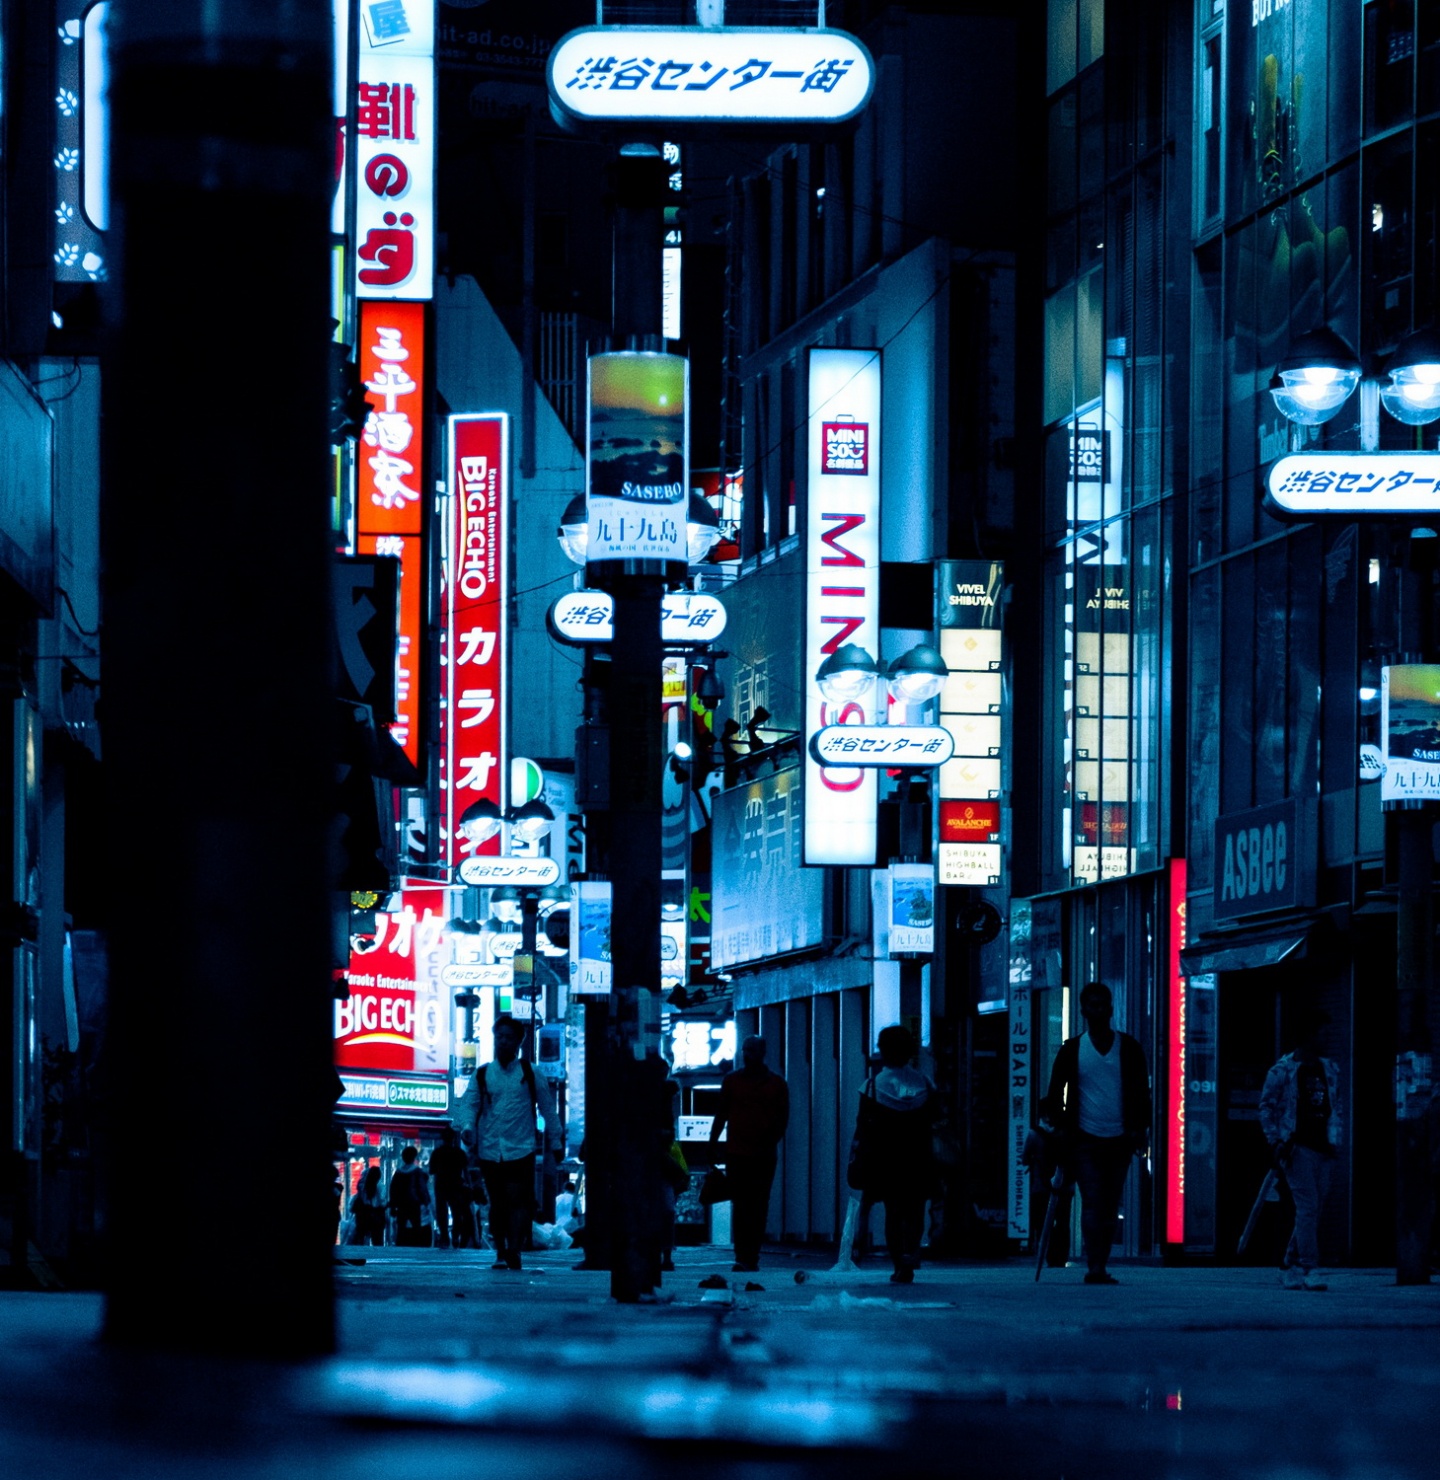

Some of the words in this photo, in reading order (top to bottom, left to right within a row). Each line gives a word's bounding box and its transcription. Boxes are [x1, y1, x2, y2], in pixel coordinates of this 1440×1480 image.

[566, 56, 855, 93] 渋谷センター街
[358, 82, 416, 286] 靴のダ
[826, 429, 865, 443] MINI
[461, 456, 487, 512] BIG
[488, 468, 497, 508] Karaoke
[621, 481, 682, 500] SASEBO
[1279, 470, 1440, 493] 渋谷センター
[595, 517, 678, 545] 九十九島
[460, 516, 487, 599] ECHO
[486, 511, 497, 583] Entertainment
[949, 595, 994, 606] SHIBUYA
[957, 584, 986, 595] VIVEL
[455, 626, 497, 853] カラオ
[823, 737, 945, 753] 渋谷センター街
[1394, 771, 1440, 788] 九十九
[946, 818, 992, 828] AVALANCHE
[946, 849, 987, 857] SHIBUYA
[946, 861, 994, 869] HIGHBALL
[464, 865, 554, 878] 渋谷センター街
[445, 970, 510, 980] 渋谷センター街
[335, 993, 378, 1039] BIG
[380, 997, 442, 1046] ECHO
[1012, 1043, 1028, 1088] BAR
[1014, 1124, 1024, 1167] SHIBUYA
[1014, 1169, 1024, 1218] HIGHBALL
